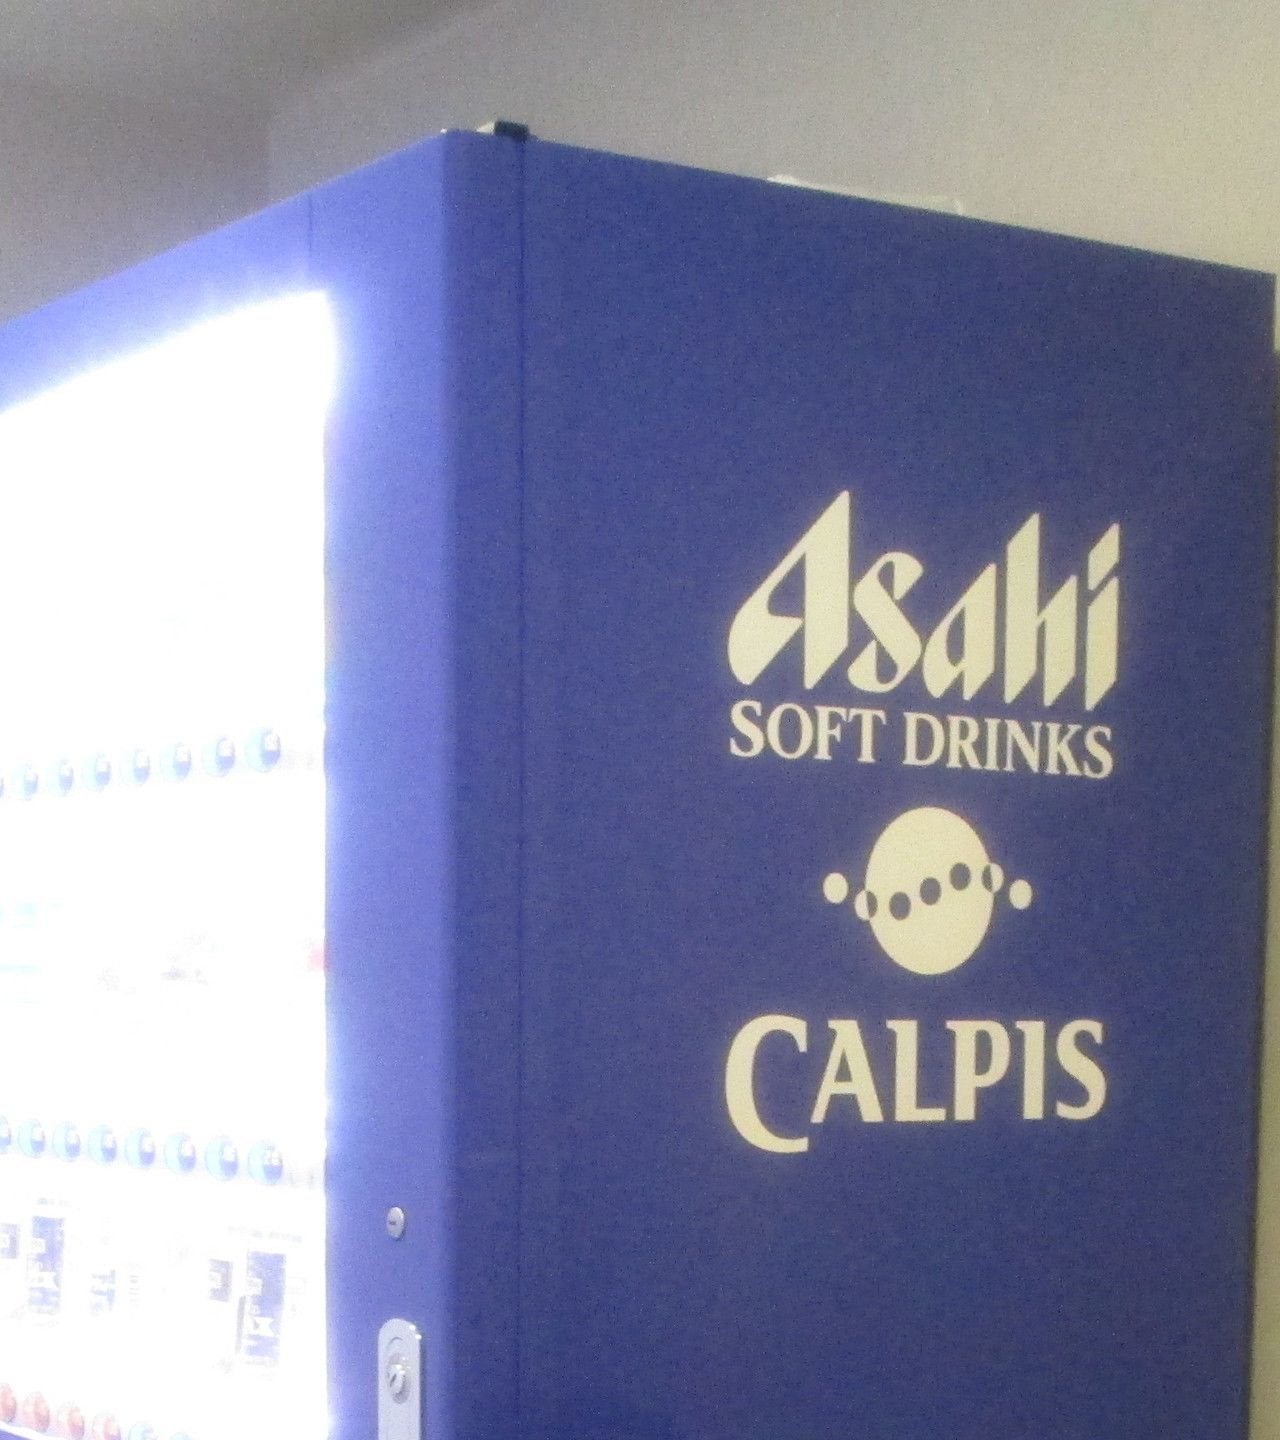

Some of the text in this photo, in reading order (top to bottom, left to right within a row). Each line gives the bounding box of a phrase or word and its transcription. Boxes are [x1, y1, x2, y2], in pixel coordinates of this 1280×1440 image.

[728, 490, 1121, 712] Asahi
[729, 699, 1114, 780] SOFT DRINKS
[725, 1014, 1108, 1154] CALPIS
